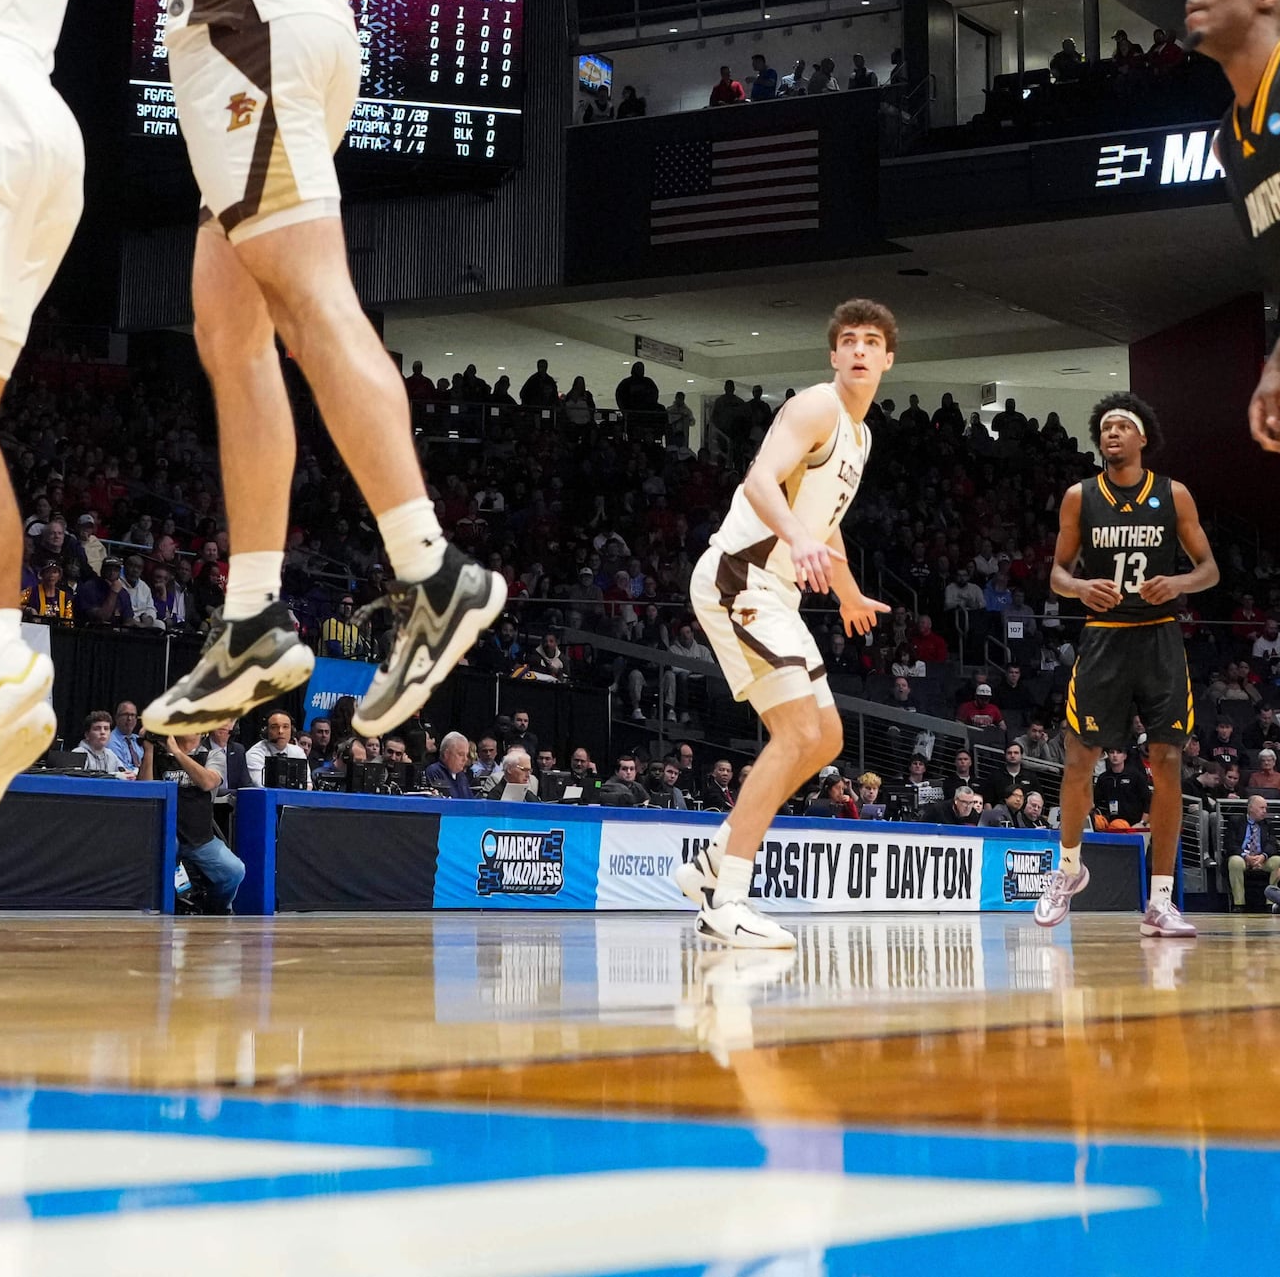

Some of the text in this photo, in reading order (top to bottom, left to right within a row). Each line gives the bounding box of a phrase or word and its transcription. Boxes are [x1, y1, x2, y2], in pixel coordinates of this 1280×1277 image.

[430, 4, 440, 17] 0
[457, 6, 465, 19] 1
[481, 8, 489, 20] 1
[503, 10, 511, 24] 1
[359, 14, 512, 40] 4 2 2 0 0
[430, 36, 439, 49] 0
[455, 38, 465, 51] 0
[480, 40, 490, 53] 0
[502, 42, 512, 55] 0
[430, 53, 439, 66] 2
[455, 55, 465, 68] 4
[480, 57, 488, 70] 1
[501, 58, 512, 72] 0
[430, 70, 439, 83] 8
[455, 71, 465, 85] 8
[479, 73, 489, 86] 2
[501, 75, 512, 88] 0
[143, 87, 177, 103] FG/FG
[136, 102, 181, 120] 3PT/3PT
[454, 111, 473, 125] STL
[486, 114, 495, 126] 3
[143, 120, 178, 136] FT/FTA
[393, 123, 402, 135] 3
[453, 127, 473, 141] BLK
[486, 130, 495, 142] 0
[349, 136, 383, 150] FT/FTA
[393, 139, 402, 151] 4
[455, 143, 470, 156] TO
[485, 145, 495, 158] 6
[1091, 525, 1165, 549] PANTHERS
[1113, 552, 1149, 595] 13
[1009, 626, 1021, 634] 107
[495, 835, 542, 861] MARCH
[501, 861, 562, 885] MADNESS
[609, 854, 655, 876] HOSTED
[657, 856, 674, 877] BY
[847, 843, 879, 899] OF
[885, 844, 973, 900] DAYTON
[1013, 854, 1041, 873] MARCH
